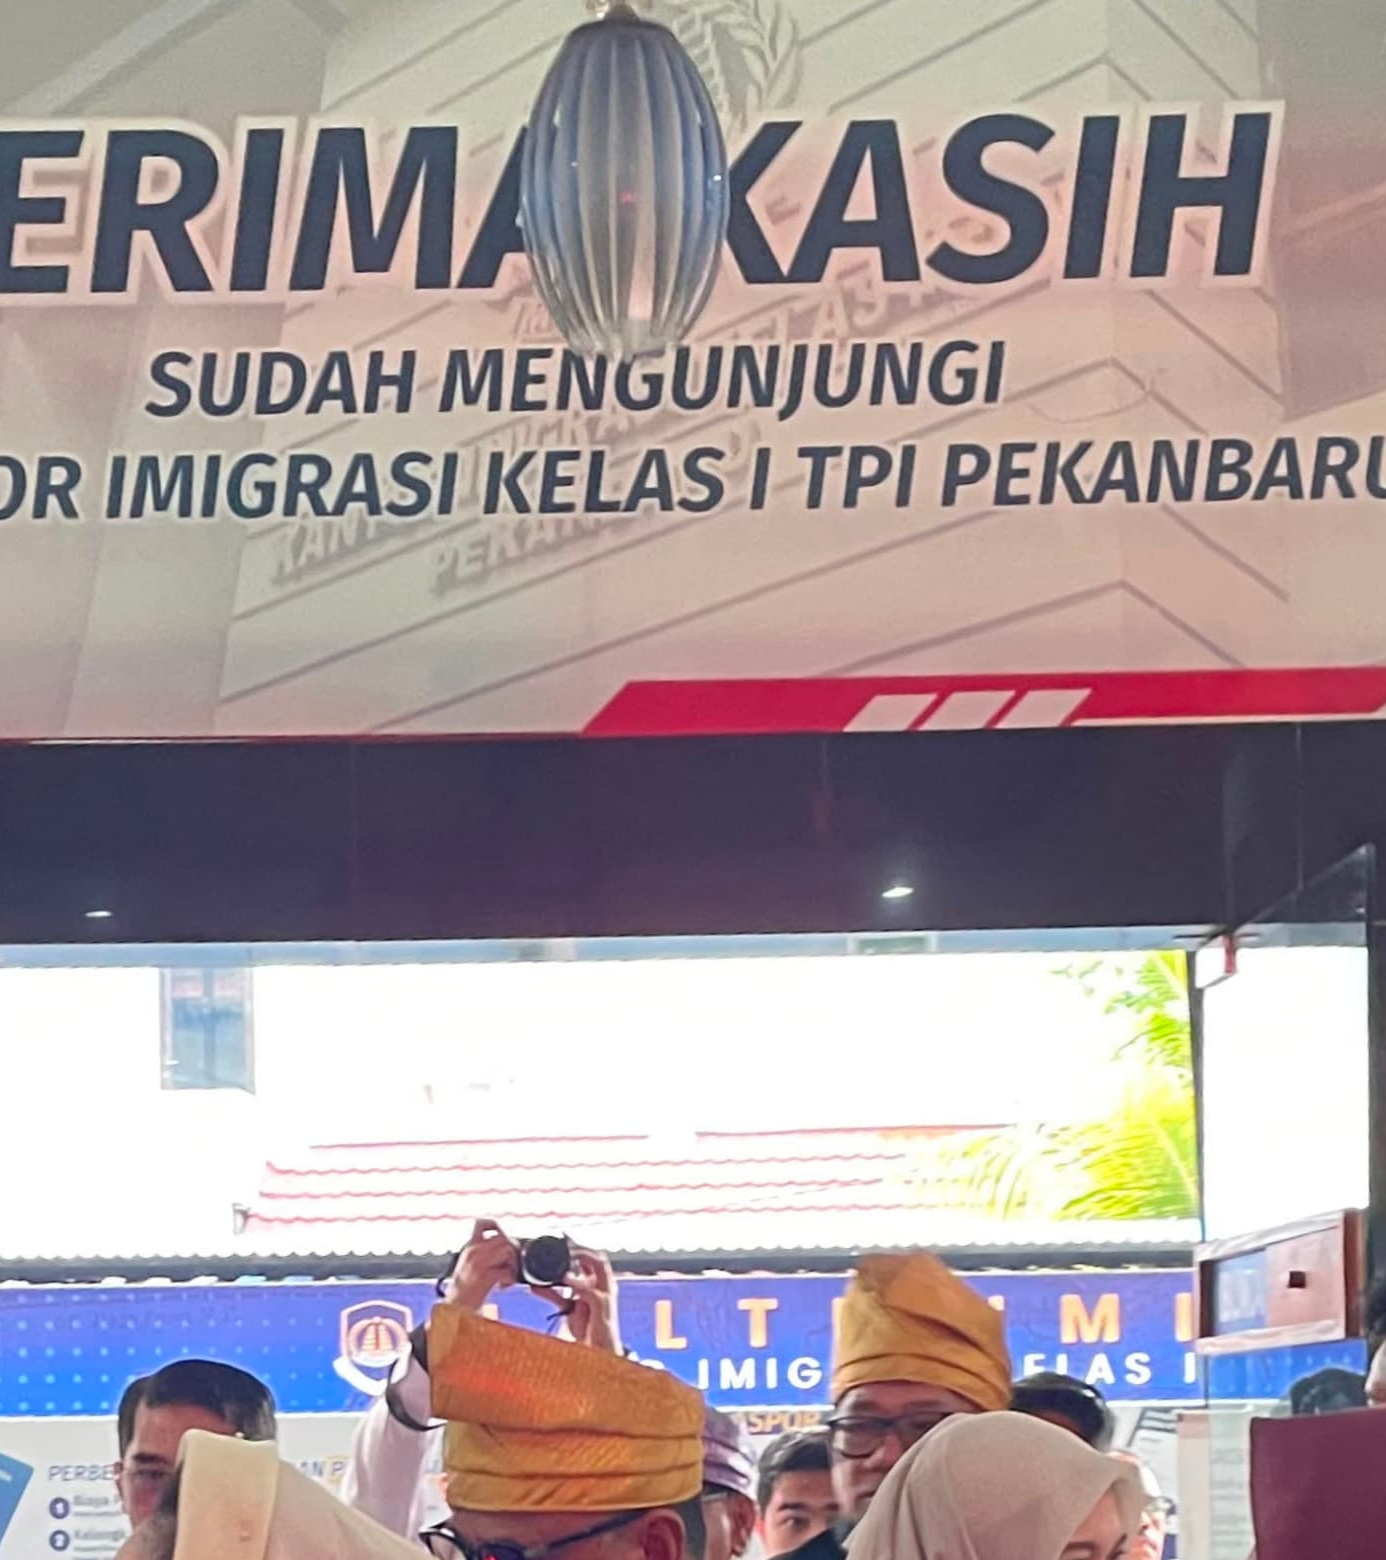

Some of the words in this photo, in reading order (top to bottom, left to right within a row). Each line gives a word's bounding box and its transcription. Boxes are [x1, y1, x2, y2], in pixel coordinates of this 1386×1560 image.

[145, 350, 416, 417] SUDAH
[439, 340, 1004, 422] MENGUNJUNGI
[106, 451, 458, 520] IMIGRASI
[483, 447, 725, 515] KELAS
[750, 447, 771, 510] I
[798, 444, 916, 509] TPI
[697, 1357, 823, 1390] IMIG
